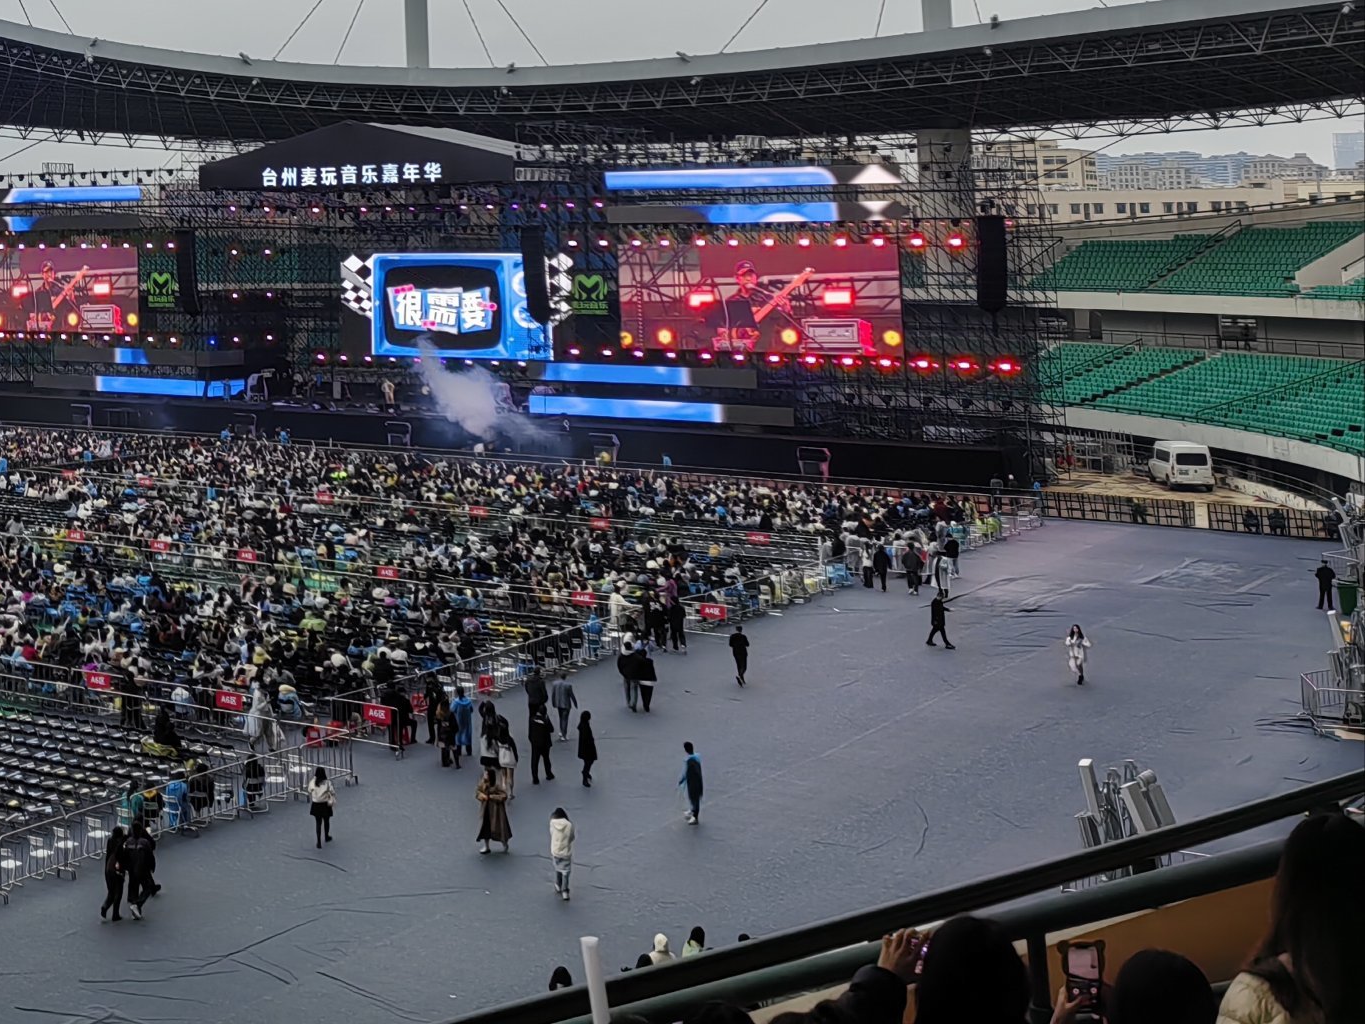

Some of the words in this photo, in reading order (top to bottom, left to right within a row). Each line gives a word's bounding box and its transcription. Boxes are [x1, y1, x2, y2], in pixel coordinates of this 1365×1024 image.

[262, 162, 442, 187] 台州麦玩音乐嘉年华
[396, 291, 486, 329] 很需要
[221, 695, 237, 706] A6区
[368, 708, 386, 720] A6区
